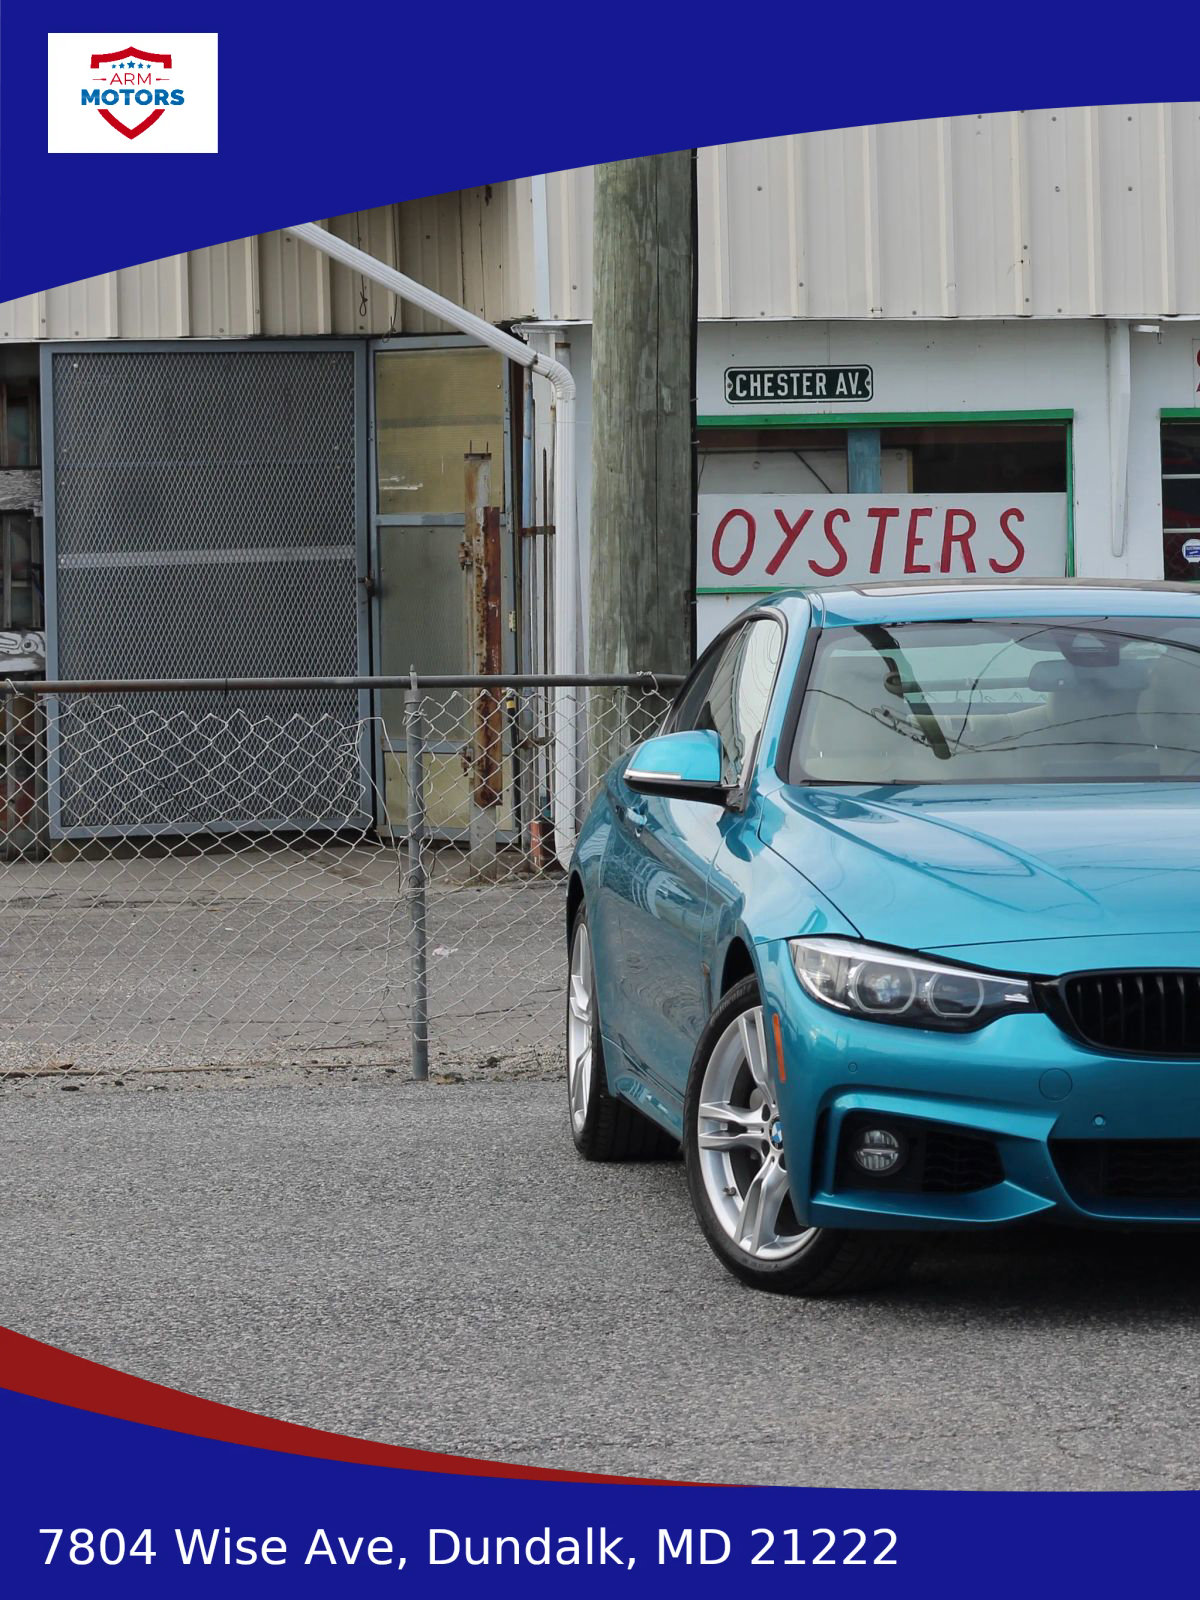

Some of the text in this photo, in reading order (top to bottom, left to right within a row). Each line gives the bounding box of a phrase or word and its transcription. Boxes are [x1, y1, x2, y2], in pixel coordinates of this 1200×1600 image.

[735, 371, 863, 398] CHESTER AV.
[711, 507, 1026, 578] OYSTERS
